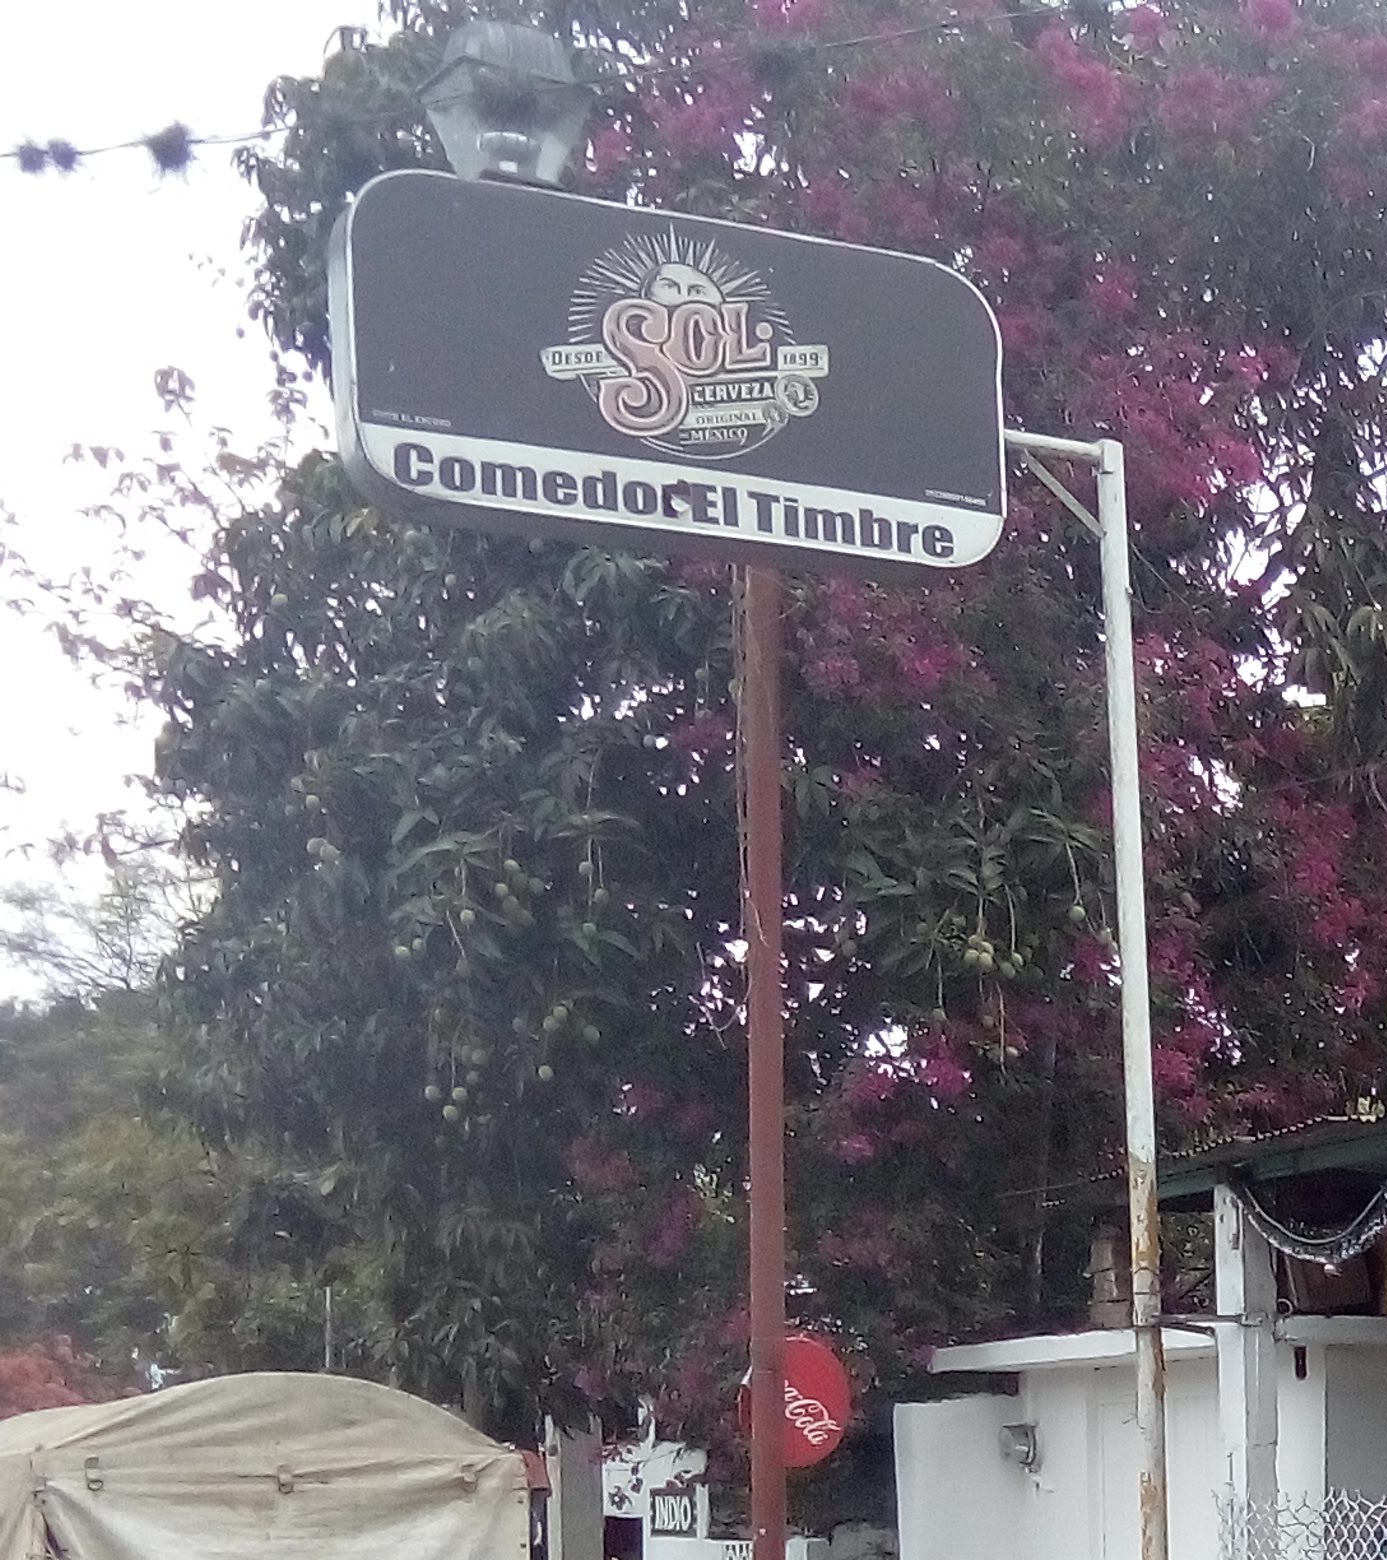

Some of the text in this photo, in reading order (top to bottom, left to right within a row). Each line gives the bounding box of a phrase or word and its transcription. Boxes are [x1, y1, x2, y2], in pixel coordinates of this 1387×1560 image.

[782, 351, 820, 367] 1899
[692, 381, 774, 402] CERVEZA
[695, 411, 758, 425] ORIGINAL
[393, 442, 955, 558] Comedor El Timbre
[654, 1494, 693, 1533] INDIO
